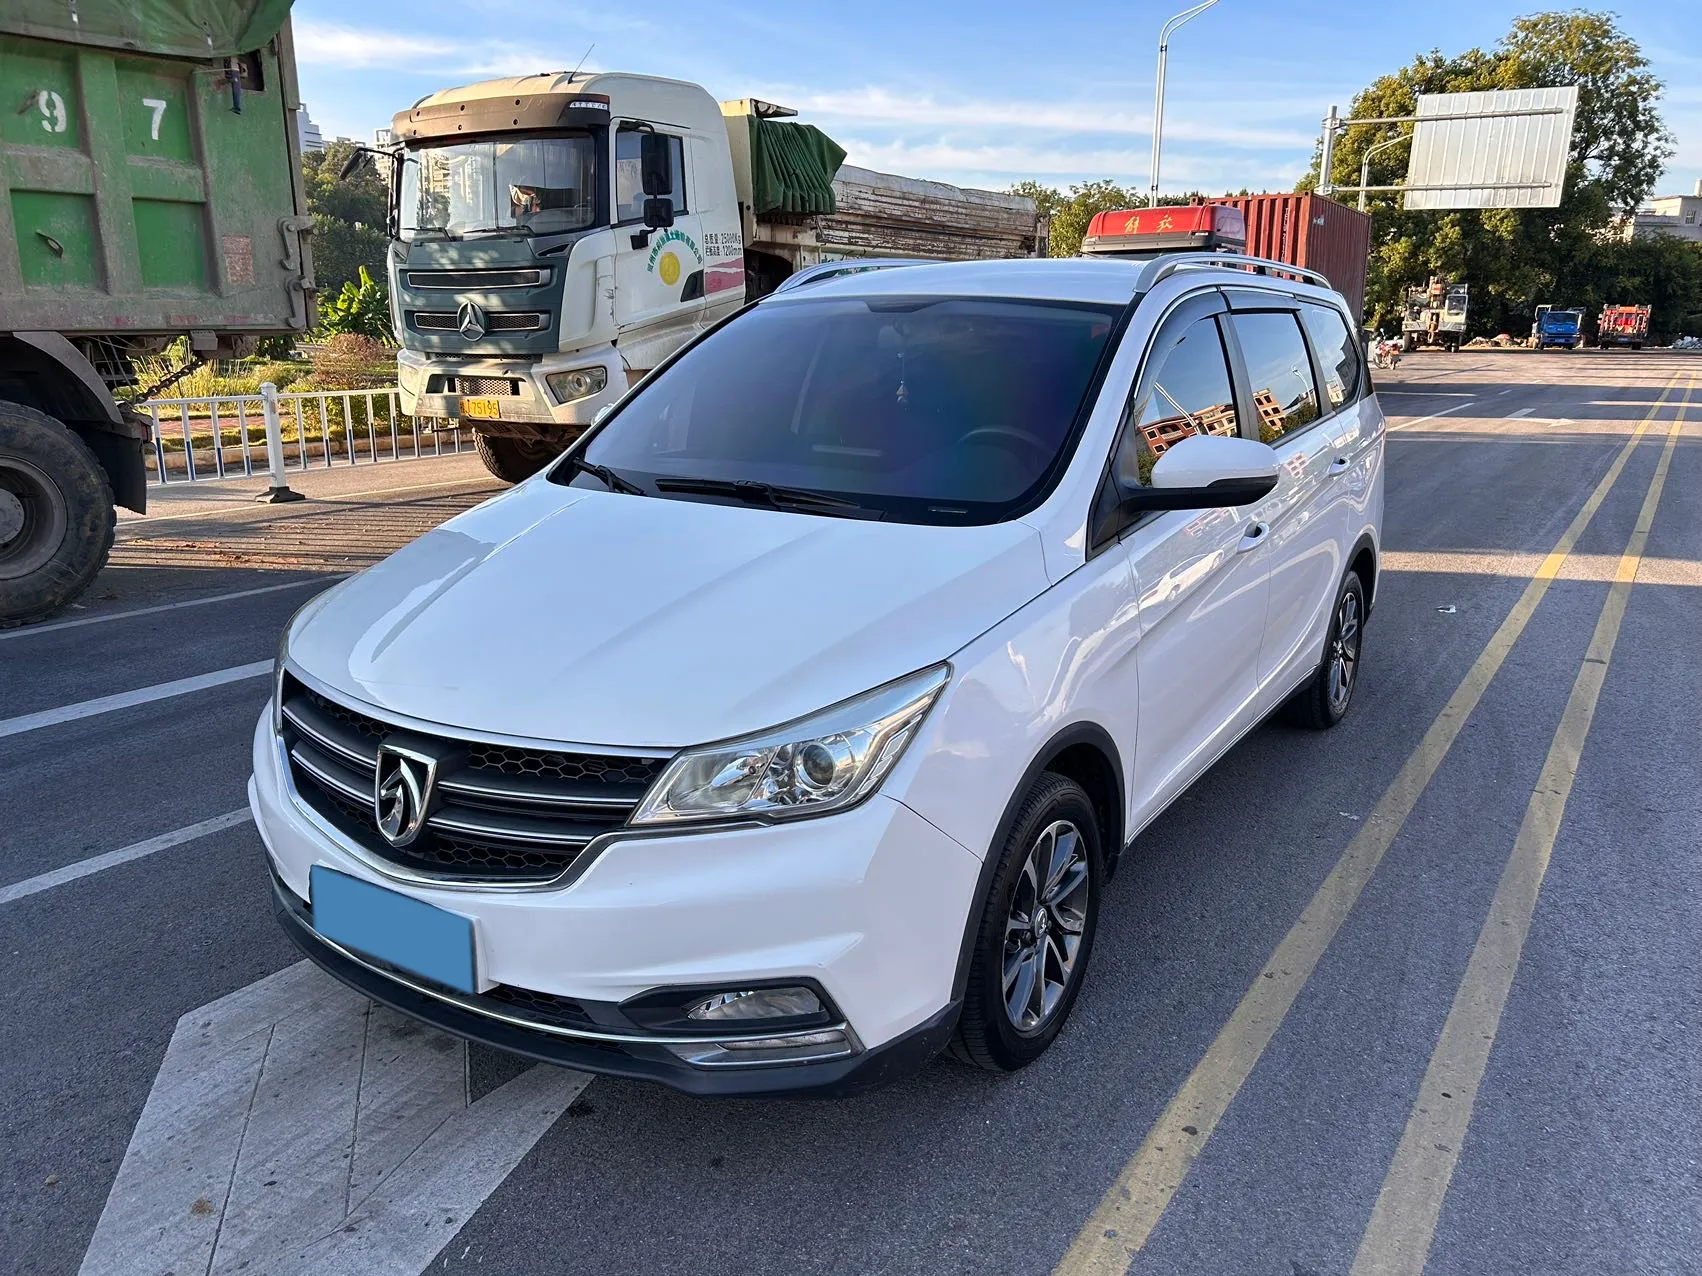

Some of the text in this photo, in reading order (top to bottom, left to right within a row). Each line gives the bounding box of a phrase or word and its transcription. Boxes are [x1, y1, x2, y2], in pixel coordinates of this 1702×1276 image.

[39, 90, 167, 140] 9 7
[1124, 215, 1173, 234] 解放
